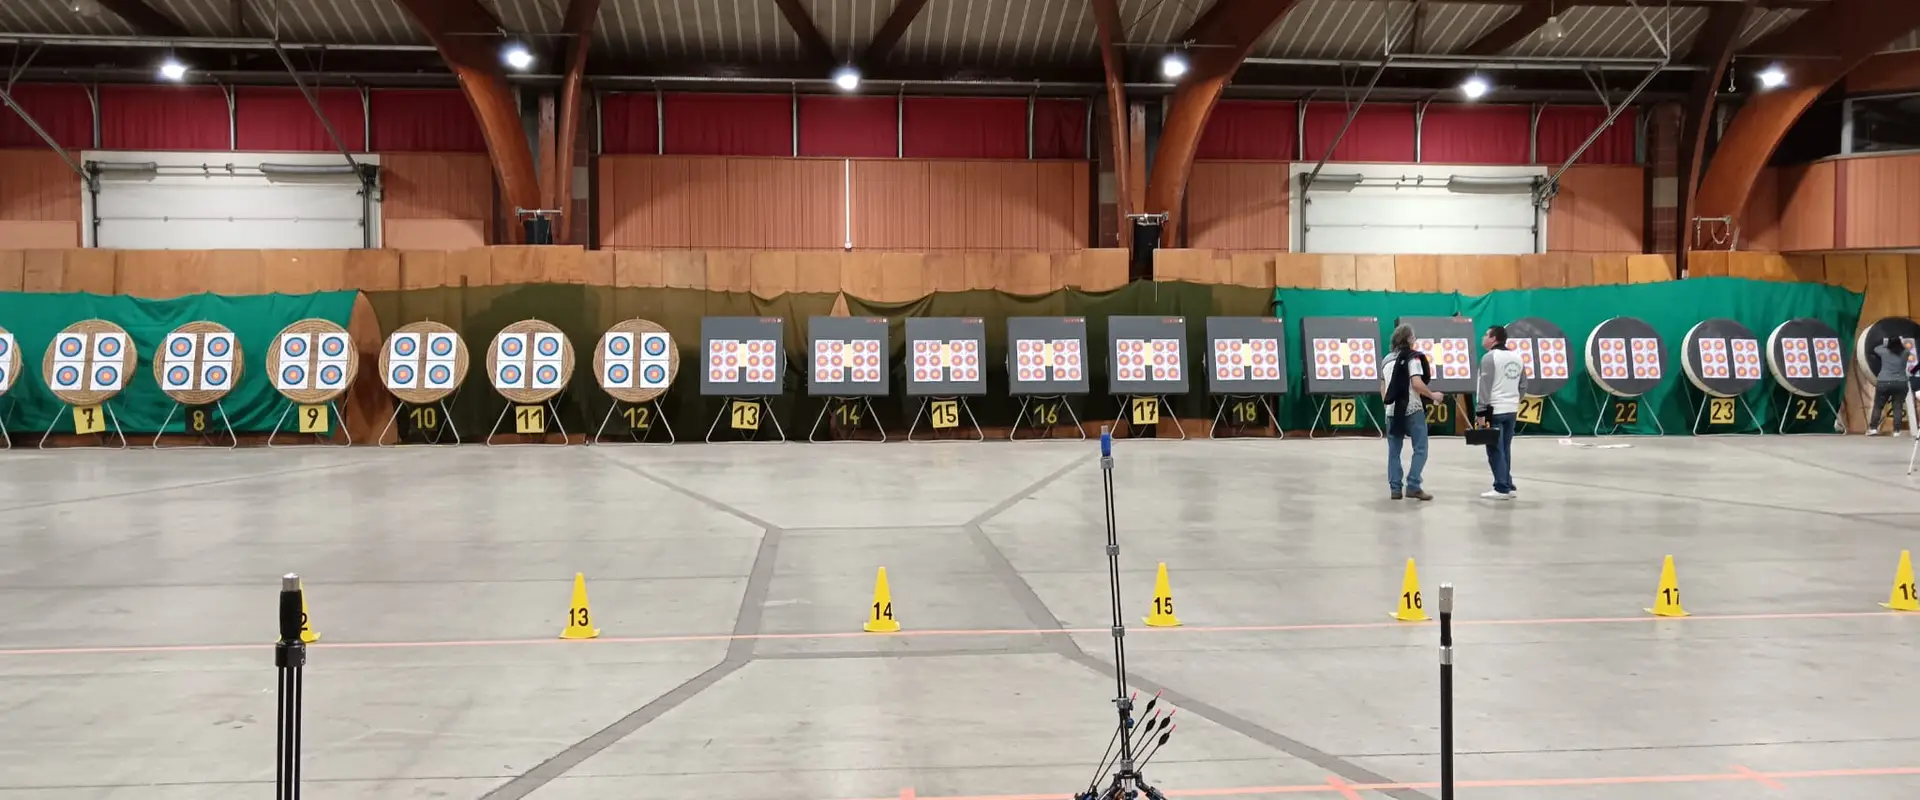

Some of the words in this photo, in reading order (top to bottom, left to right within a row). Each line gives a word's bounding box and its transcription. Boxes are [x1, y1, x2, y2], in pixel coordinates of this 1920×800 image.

[82, 408, 94, 429] 7
[307, 408, 319, 429] 9
[410, 407, 436, 429] 10
[517, 408, 542, 430] 11
[624, 407, 649, 428] 12
[734, 405, 758, 426] 13
[836, 404, 860, 425] 14
[933, 403, 956, 424] 15
[1034, 404, 1057, 424] 16
[1134, 401, 1156, 421] 17
[1232, 402, 1256, 422] 18
[1332, 402, 1354, 422] 19
[1425, 403, 1448, 423] 20
[1518, 400, 1541, 421] 21
[1615, 403, 1636, 422] 22
[1712, 401, 1733, 420] 23
[1796, 399, 1818, 420] 24
[193, 410, 205, 431] 8
[1154, 597, 1173, 615] 15
[1403, 591, 1422, 609] 16
[1663, 588, 1680, 605] 17
[301, 612, 308, 630] 2
[570, 607, 589, 626] 13
[873, 602, 892, 620] 14
